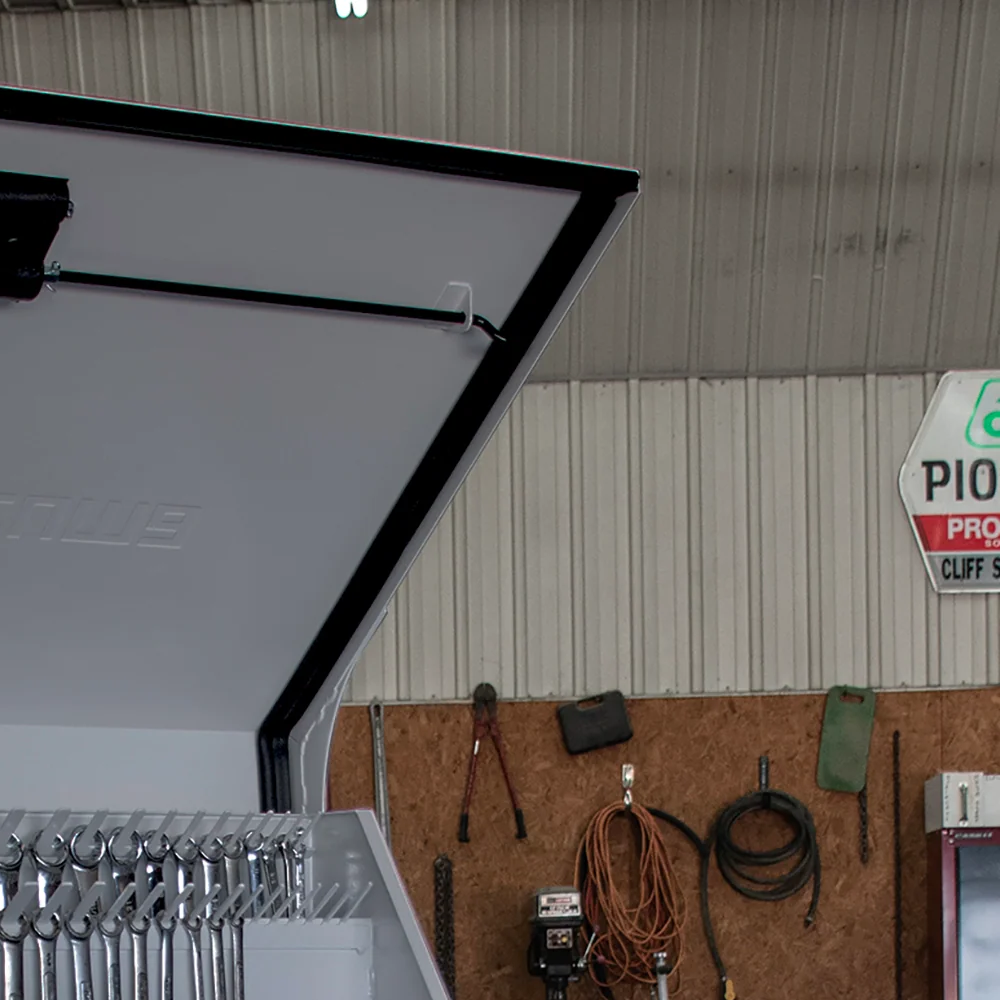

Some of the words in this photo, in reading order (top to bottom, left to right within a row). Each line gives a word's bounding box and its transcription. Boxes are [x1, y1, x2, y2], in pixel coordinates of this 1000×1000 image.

[921, 459, 997, 501] PIO
[947, 518, 1000, 539] PRO
[942, 558, 984, 580] CLIFF
